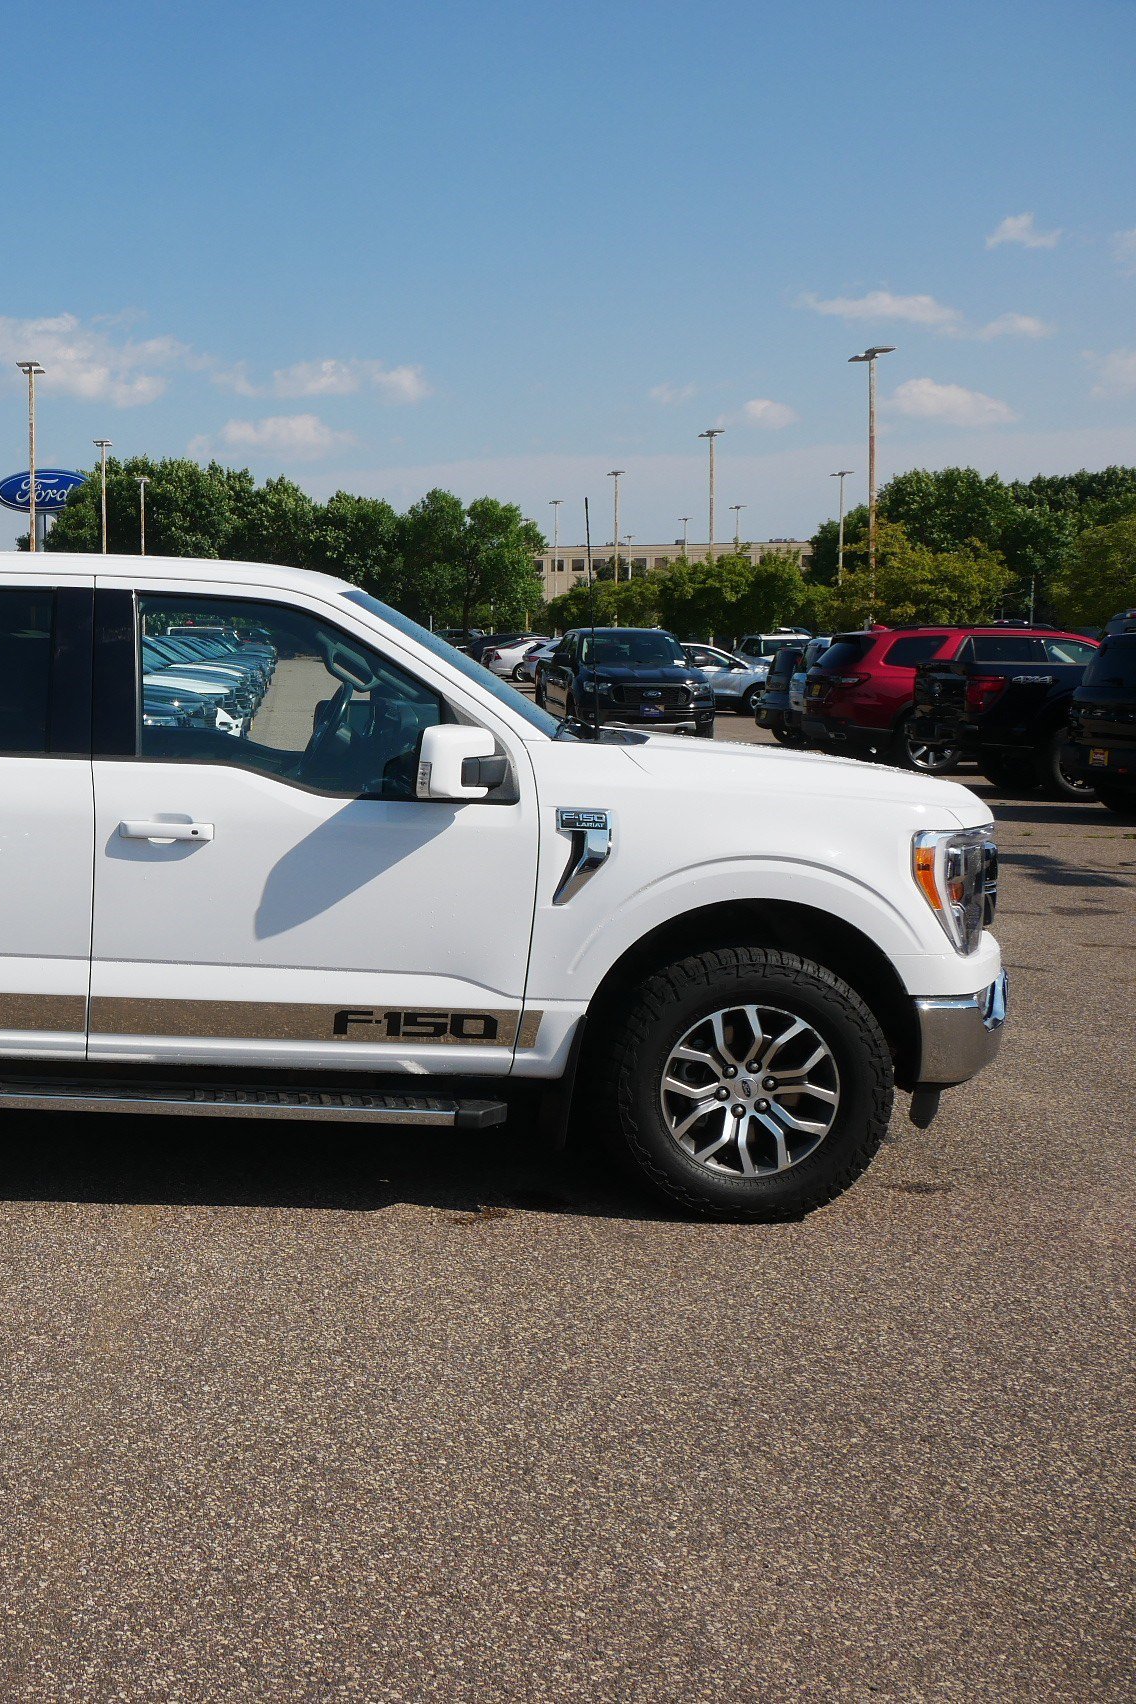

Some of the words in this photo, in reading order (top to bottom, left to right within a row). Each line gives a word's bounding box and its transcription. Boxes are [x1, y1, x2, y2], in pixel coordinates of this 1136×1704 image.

[15, 478, 74, 503] Ford
[562, 812, 606, 822] F-150
[333, 1010, 498, 1040] F-150
